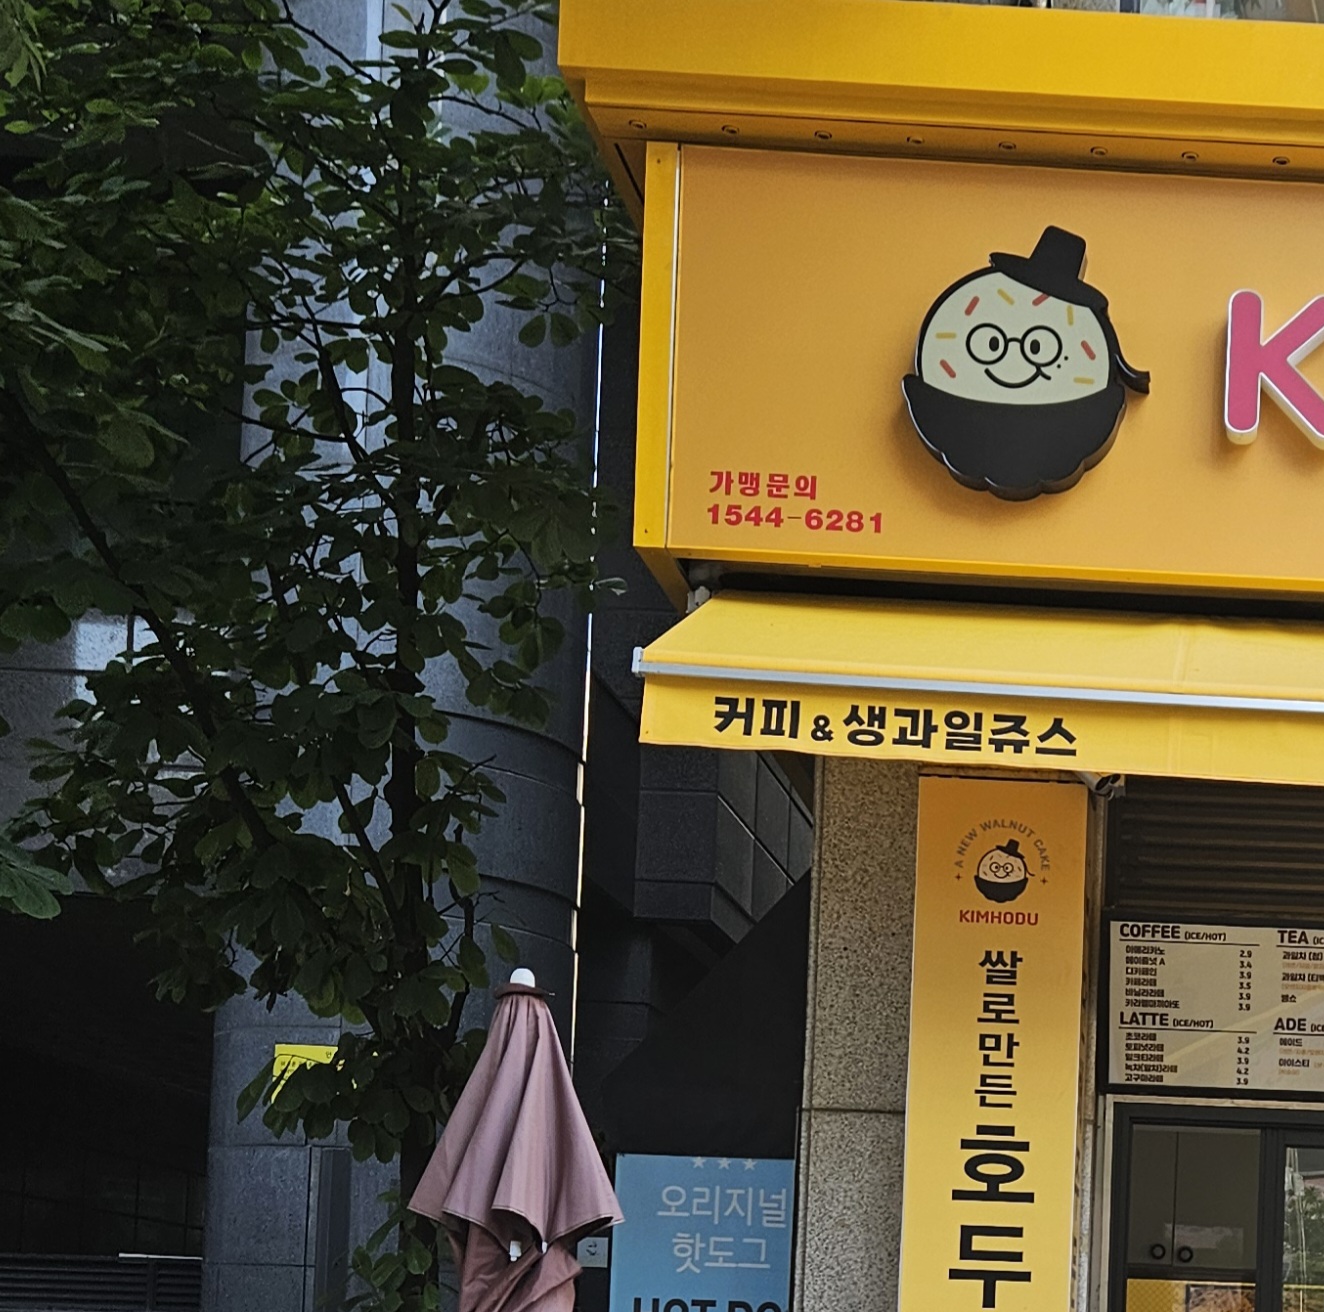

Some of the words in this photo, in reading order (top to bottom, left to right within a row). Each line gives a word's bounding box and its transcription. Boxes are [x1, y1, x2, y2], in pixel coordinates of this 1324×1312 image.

[708, 470, 818, 500] 가맹문의
[706, 503, 884, 534] 1544-6281
[979, 819, 1036, 838] WALNUT
[956, 828, 978, 856] NEW
[1033, 839, 1050, 871] CAKE
[954, 860, 964, 868] A
[959, 909, 1039, 926] KIMHODU
[1120, 923, 1180, 939] COFFEE
[1184, 931, 1226, 941] (ICE/HOT)
[1278, 930, 1308, 944] TEA
[1126, 945, 1165, 955] 아메리카노
[1240, 950, 1252, 958] 2.9
[1240, 961, 1252, 969] 3.4
[1239, 1003, 1250, 1011] 3.9
[1120, 1012, 1169, 1026] LATTE
[1173, 1018, 1213, 1028] (ICE/HOT)
[1274, 1018, 1306, 1031] ADE
[1237, 1047, 1249, 1055] 4.2
[656, 1185, 787, 1228] 오리지널
[672, 1232, 770, 1274] 핫도그
